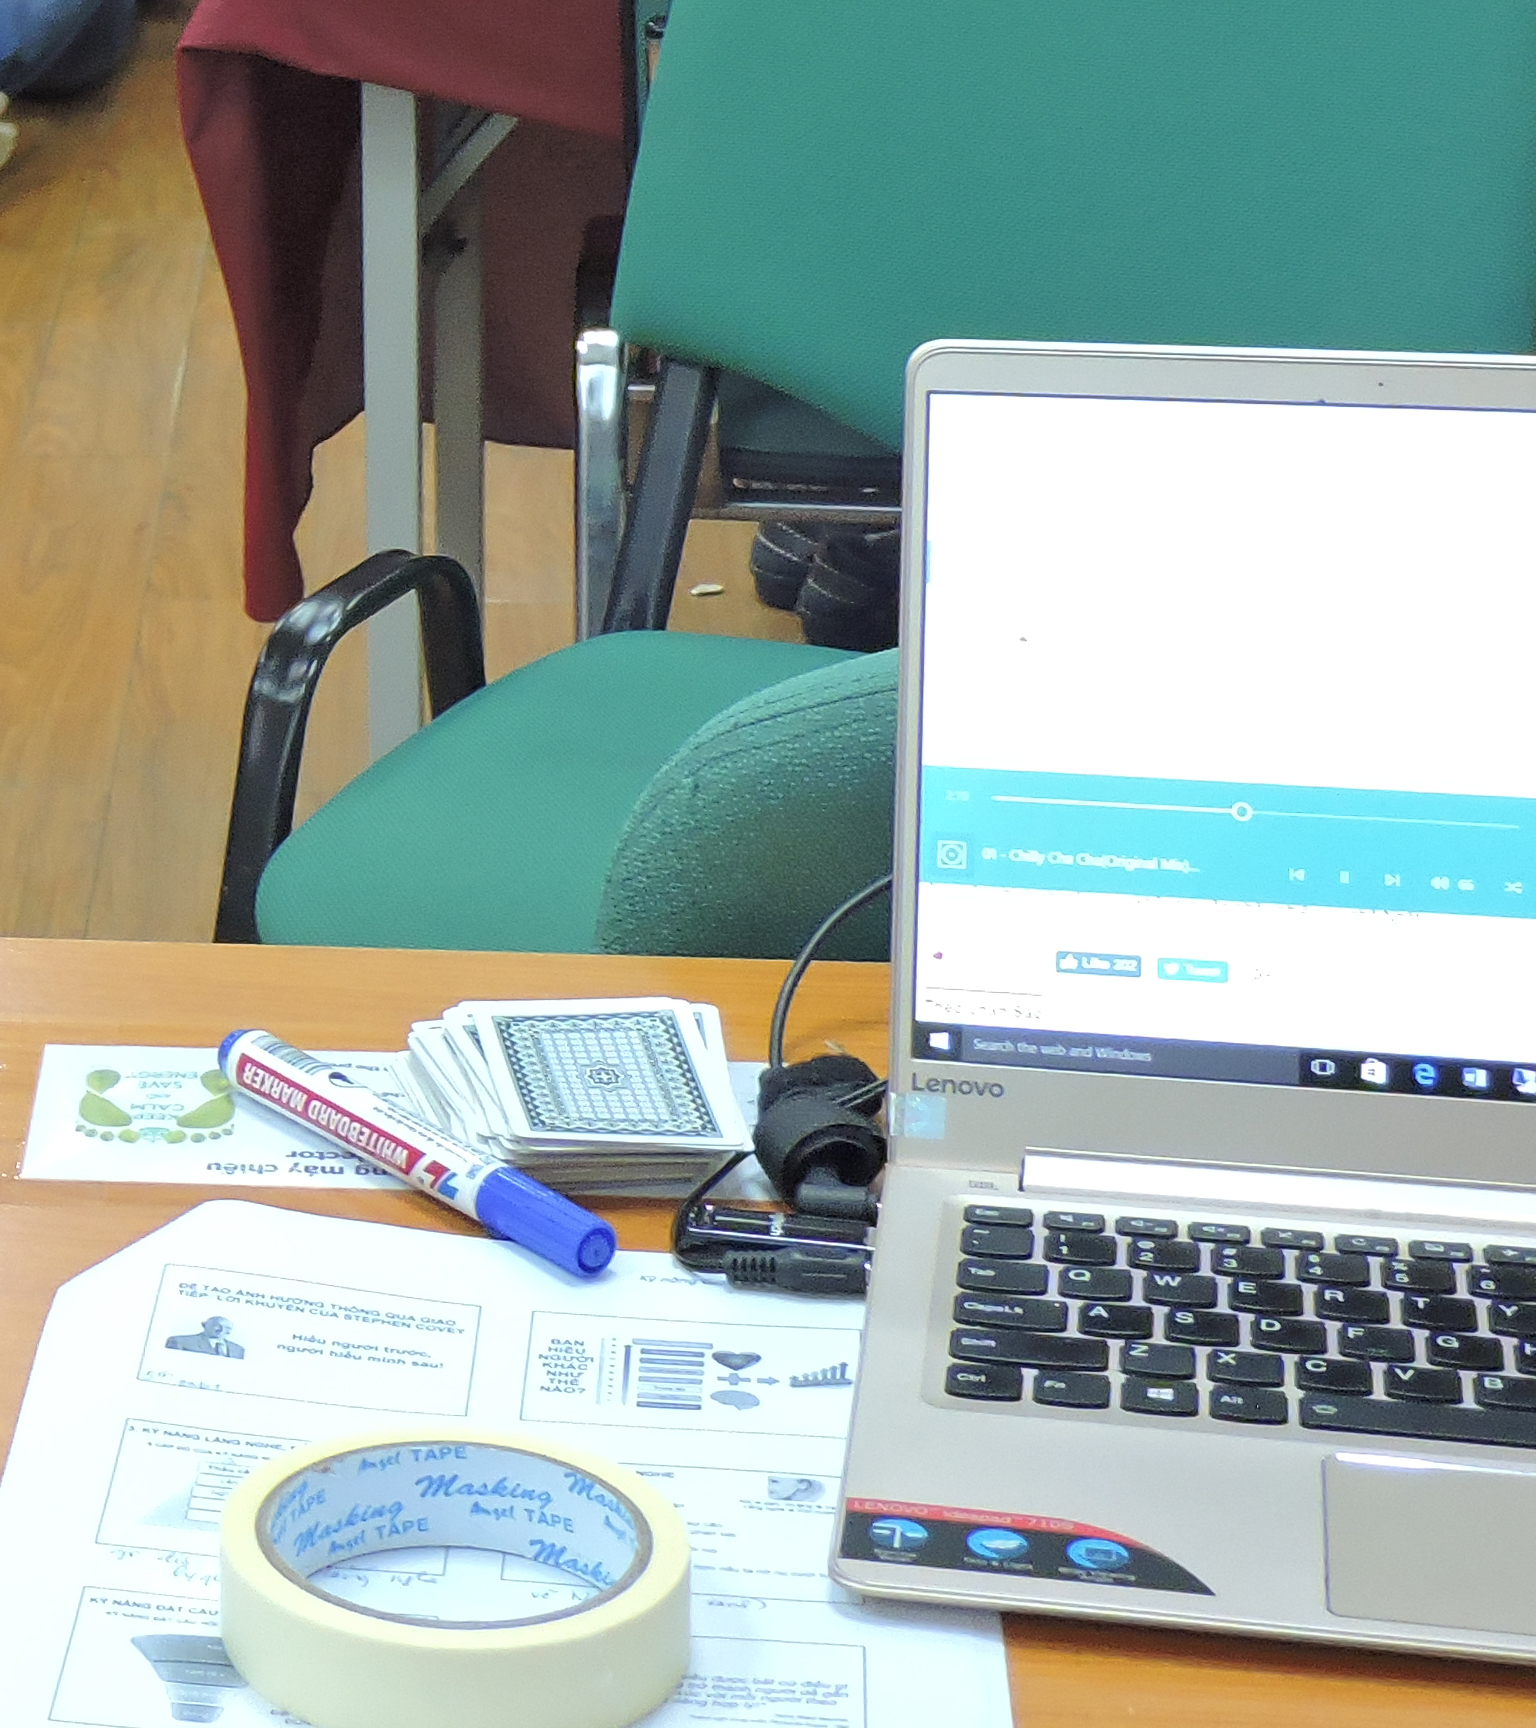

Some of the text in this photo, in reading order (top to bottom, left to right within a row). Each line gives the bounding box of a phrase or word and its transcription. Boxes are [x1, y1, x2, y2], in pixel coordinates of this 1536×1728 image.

[974, 1038, 1151, 1061] Search the web and Windows
[137, 1080, 183, 1089] SAVE
[242, 1061, 308, 1112] MARKER
[911, 1072, 1005, 1098] Lenovo
[130, 1103, 184, 1111] CALM
[309, 1102, 409, 1168] WHITEBOARD
[1139, 1252, 1154, 1262] 2
[1223, 1259, 1238, 1268] 3
[1068, 1269, 1091, 1282] Q
[1308, 1266, 1322, 1276] 4
[1154, 1274, 1182, 1287] W
[1480, 1279, 1496, 1290] 6
[1238, 1282, 1257, 1295] E
[1324, 1290, 1346, 1302] R
[1412, 1297, 1430, 1309] T
[1088, 1306, 1109, 1318] A
[1498, 1305, 1520, 1317] Y
[343, 1313, 411, 1329] STEPHEN
[415, 1323, 465, 1335] COVEY
[1175, 1312, 1195, 1324] S
[1260, 1319, 1282, 1331] D
[1347, 1327, 1365, 1339] F
[1436, 1336, 1460, 1348] G
[1129, 1345, 1150, 1357] Z
[1217, 1352, 1237, 1365] X
[1305, 1361, 1328, 1373] C
[957, 1372, 987, 1382] Ctrl
[1394, 1368, 1415, 1381] V
[1044, 1380, 1067, 1389] Fn
[1484, 1377, 1503, 1390] B
[1219, 1395, 1245, 1406] Alt
[358, 1446, 467, 1473] Angel TAPE
[415, 1474, 554, 1510] Masking
[853, 1500, 929, 1516] LENOVO
[470, 1501, 575, 1534] Angel TAPE
[293, 1501, 404, 1558] Masking
[329, 1517, 429, 1554] Angel TAPE
